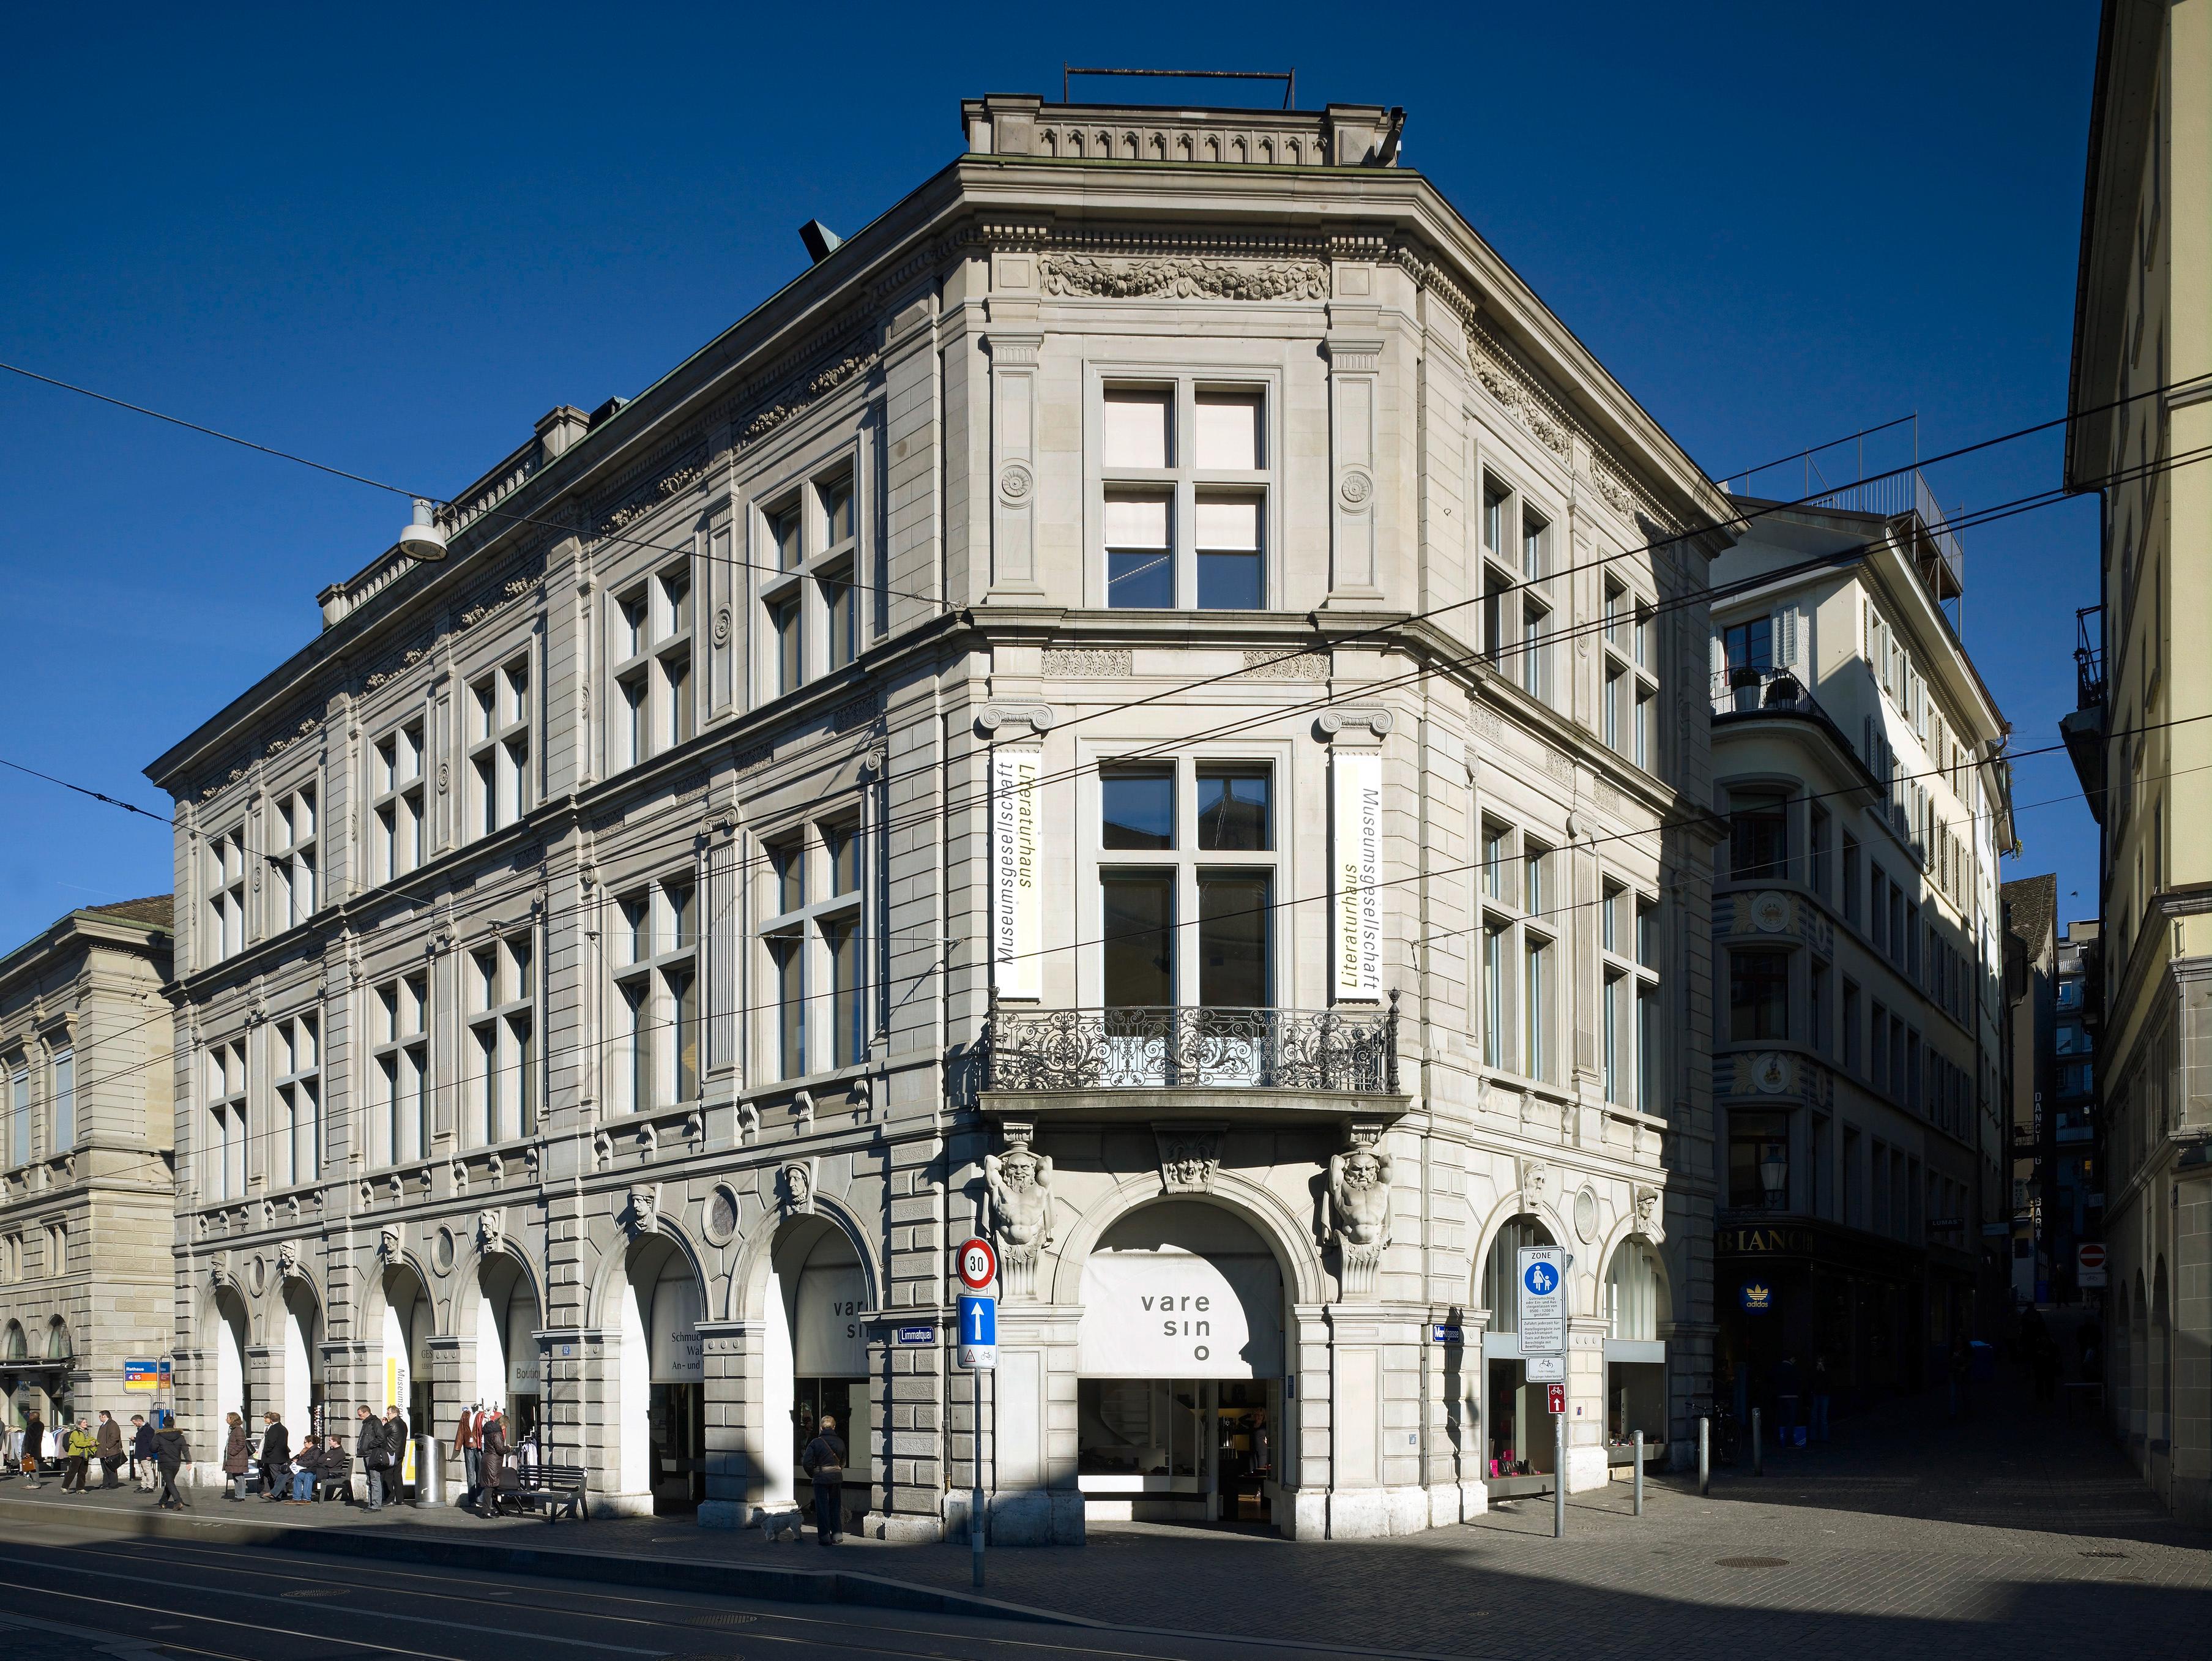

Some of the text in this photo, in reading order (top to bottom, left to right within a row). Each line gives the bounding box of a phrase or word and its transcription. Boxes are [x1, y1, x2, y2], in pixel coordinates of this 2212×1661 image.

[1019, 764, 1035, 888] Literaturhaus
[997, 763, 1017, 965] Museumsgesellschaft
[1360, 788, 1379, 990] Museumsgesellschaft
[1341, 864, 1357, 988] Literaturhaus
[970, 1256, 983, 1272] 30
[1141, 1296, 1209, 1312] vare
[901, 1328, 932, 1342] Limmatquai
[1435, 1327, 1459, 1340] Marktgasse
[688, 1360, 699, 1369] und
[516, 1368, 540, 1381] Boutiq
